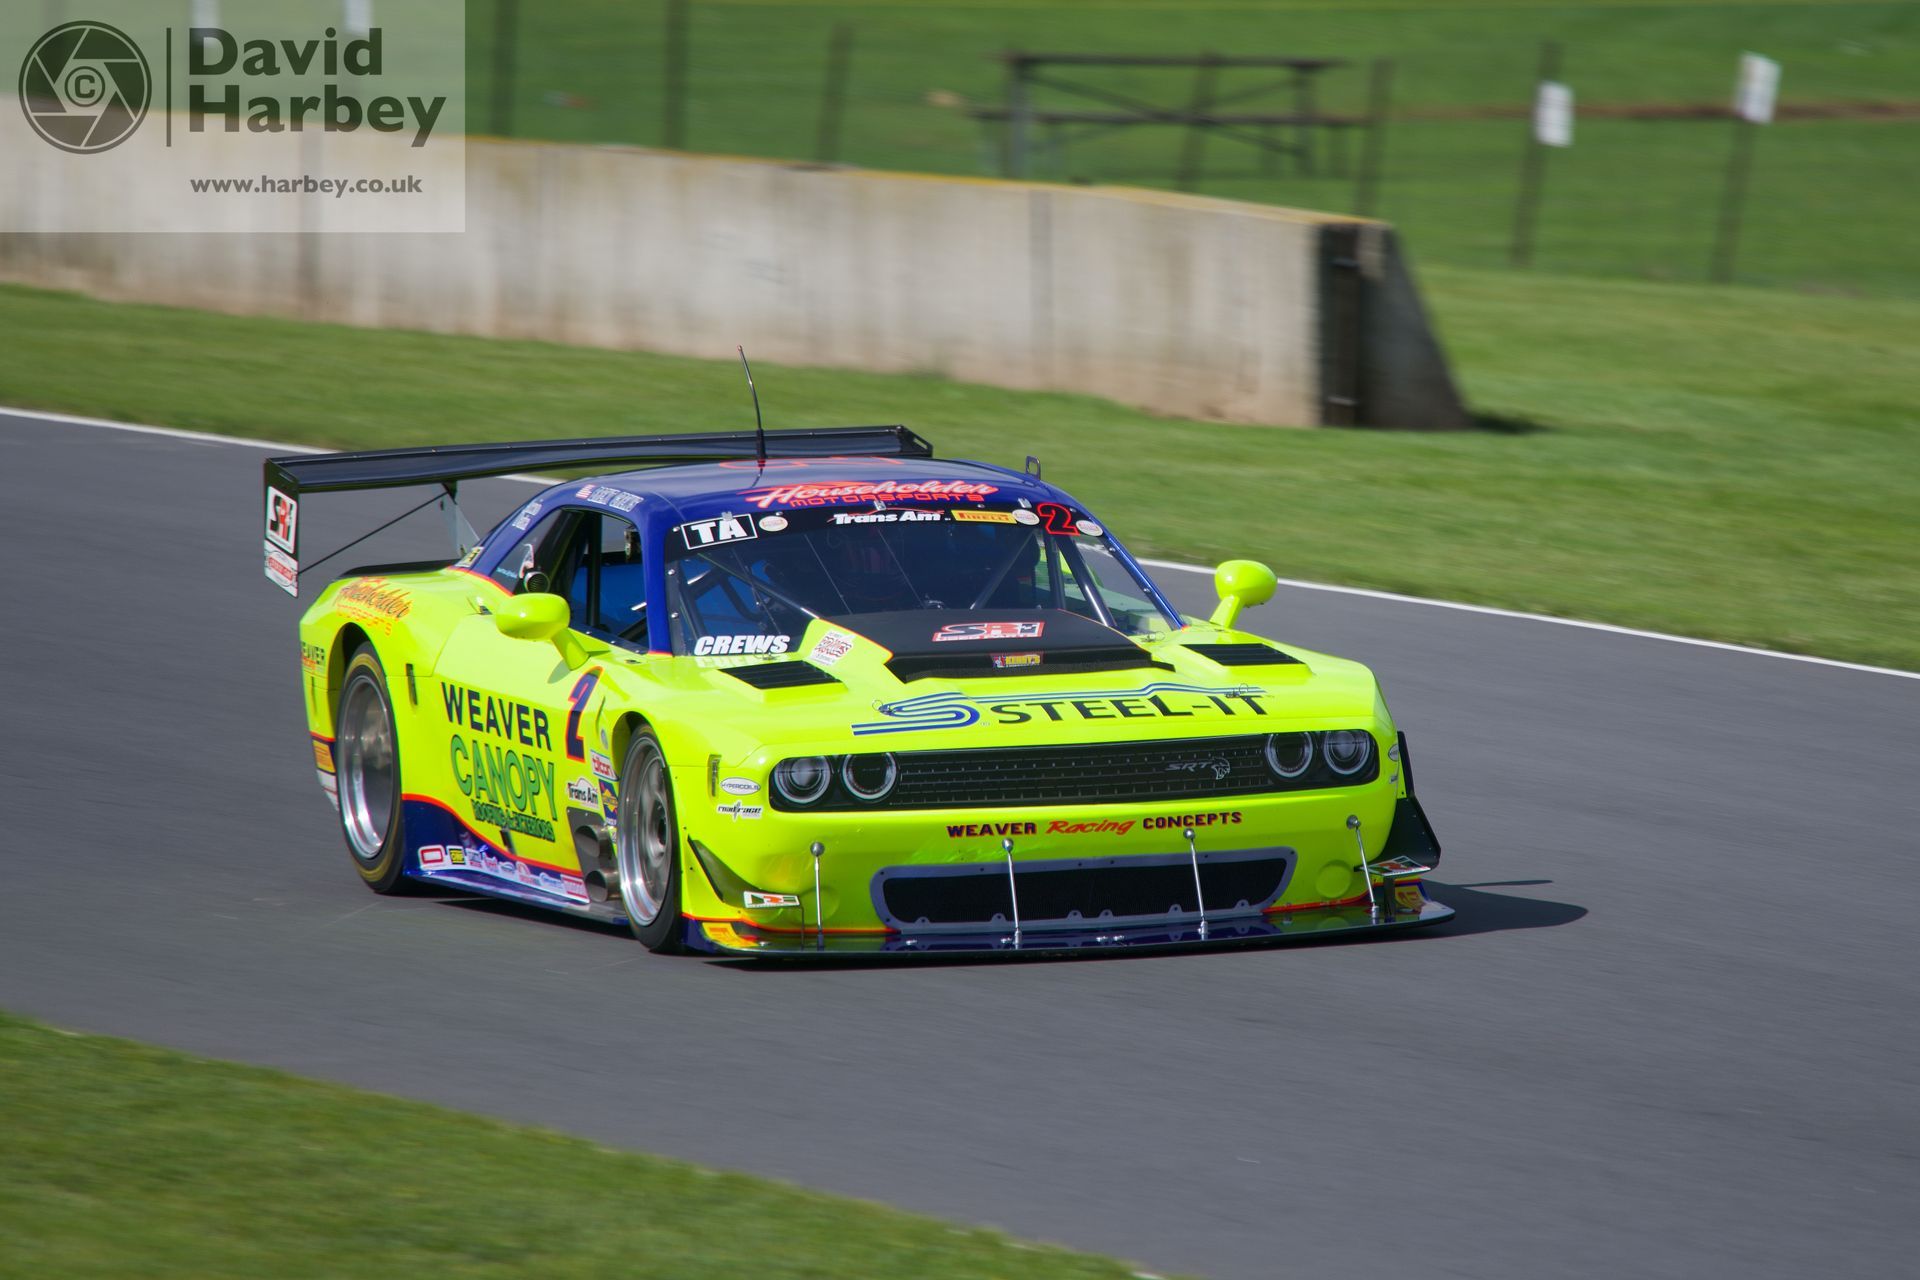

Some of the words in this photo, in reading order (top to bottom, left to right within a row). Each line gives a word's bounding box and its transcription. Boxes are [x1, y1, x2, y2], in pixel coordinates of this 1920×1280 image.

[745, 481, 999, 508] Householder
[790, 493, 985, 508] MOTORSPORTS
[833, 513, 898, 525] Trans
[899, 511, 941, 522] Am
[958, 512, 1011, 522] PIRELLI
[1037, 503, 1081, 536] 2
[691, 518, 748, 545] TA
[694, 634, 791, 656] CREWS
[441, 681, 552, 752] WEAVER
[566, 665, 604, 763] 2
[990, 694, 1268, 725] STEEL-IT
[450, 734, 558, 822] CANOPY
[1165, 761, 1212, 772] SRT
[567, 782, 586, 801] Trans
[586, 787, 599, 805] Am
[946, 822, 1037, 838] WEAVER
[1044, 818, 1137, 836] Racing
[1142, 811, 1242, 831] CONCEPTS
